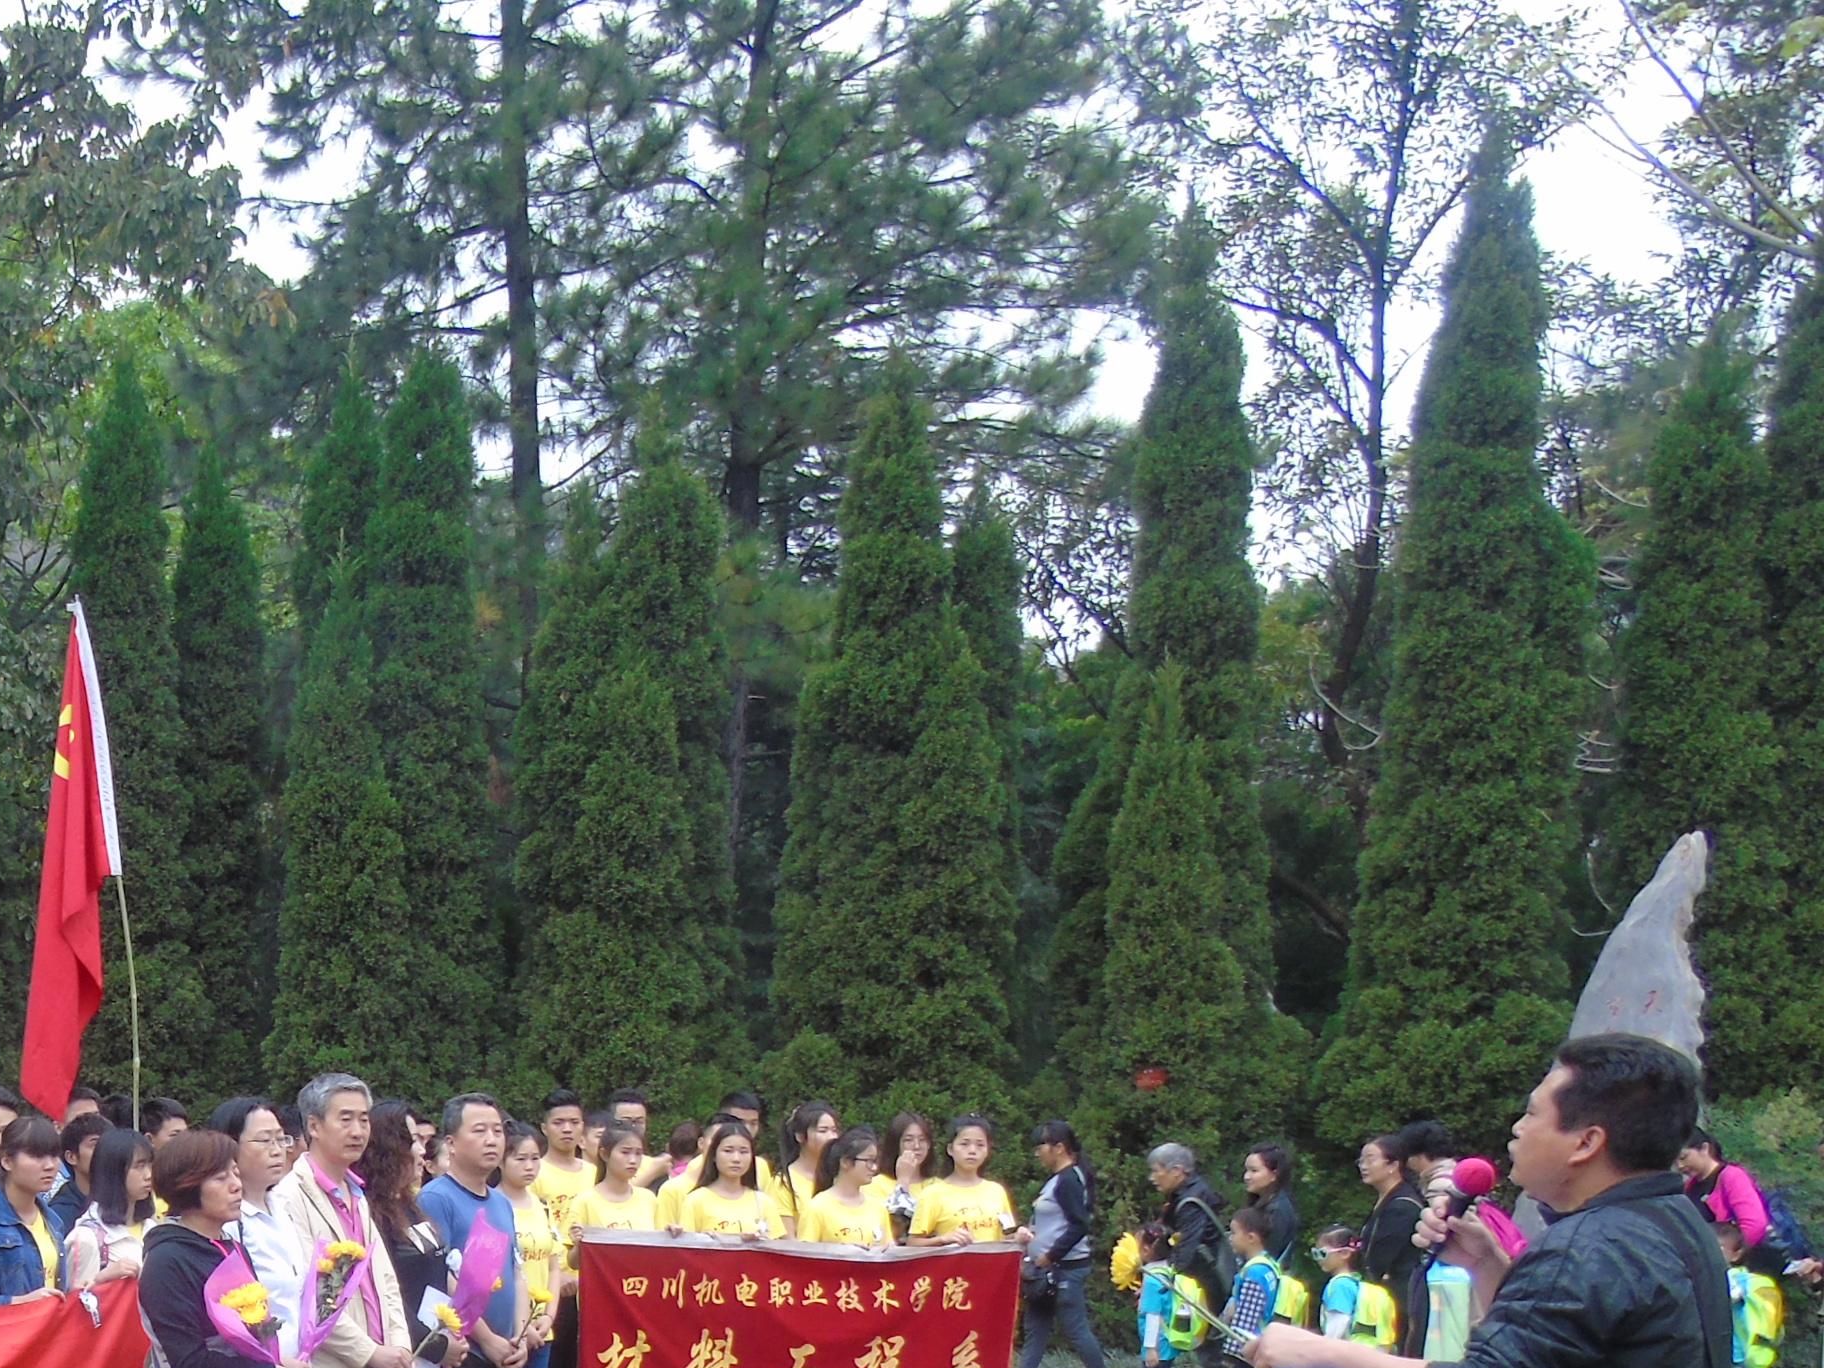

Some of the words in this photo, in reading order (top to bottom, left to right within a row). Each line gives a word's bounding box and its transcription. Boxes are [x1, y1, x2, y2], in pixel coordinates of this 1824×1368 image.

[621, 1268, 972, 1314] 四川机电职业技术学院
